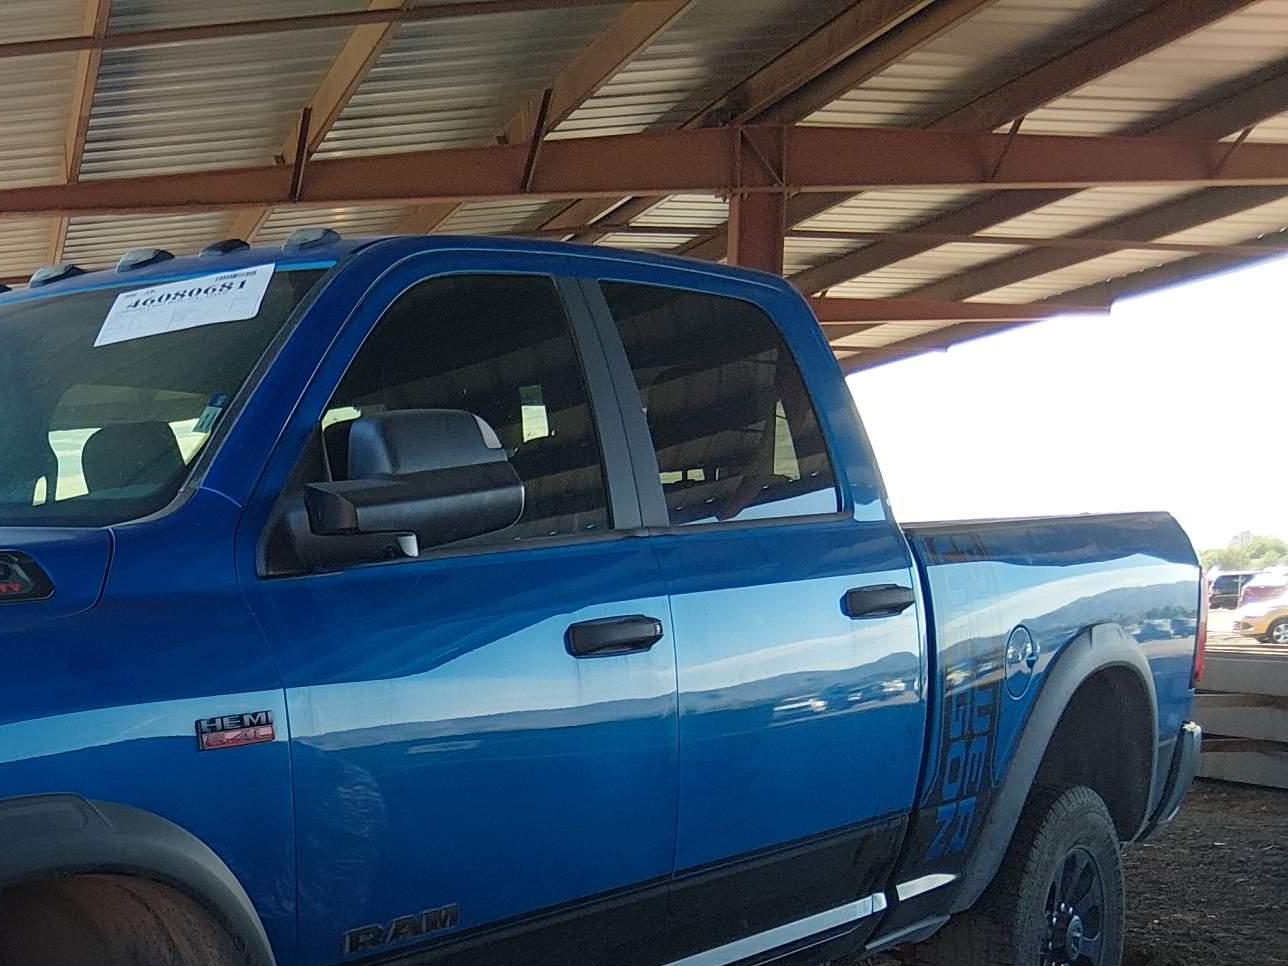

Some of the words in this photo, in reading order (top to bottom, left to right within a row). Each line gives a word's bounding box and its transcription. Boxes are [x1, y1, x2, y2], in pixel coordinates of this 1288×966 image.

[126, 279, 247, 309] 46080681
[201, 711, 273, 733] HEMI
[344, 902, 459, 953] RAM
